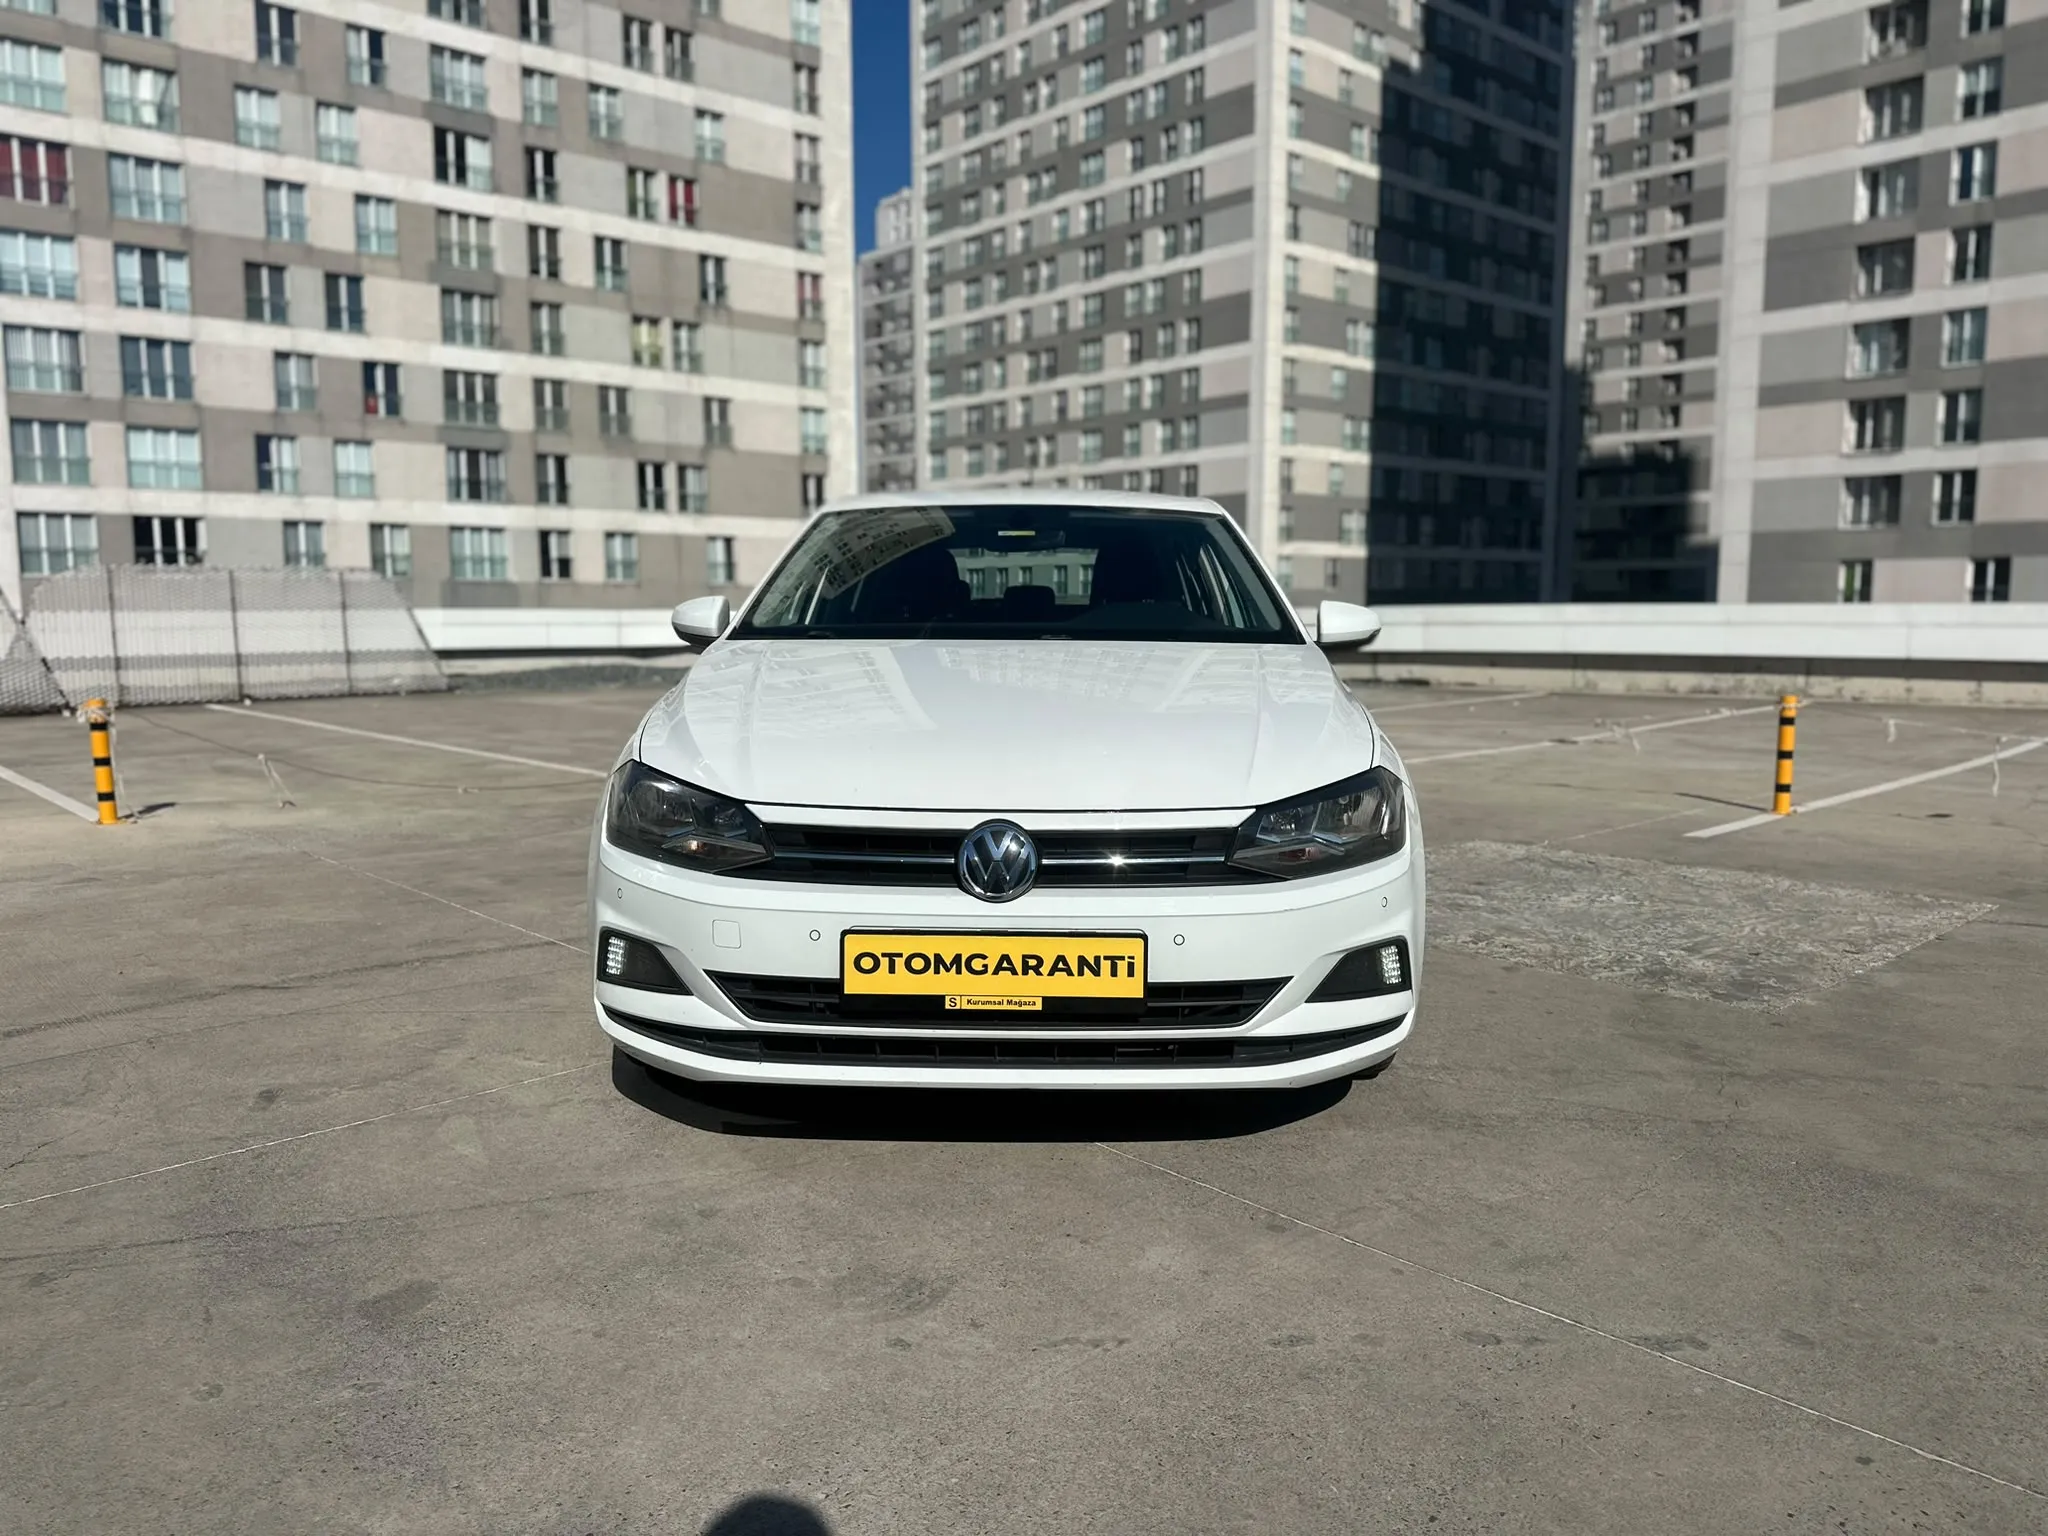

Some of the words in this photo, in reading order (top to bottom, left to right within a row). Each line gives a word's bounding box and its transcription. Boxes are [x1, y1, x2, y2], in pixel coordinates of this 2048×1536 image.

[962, 827, 1034, 896] VW
[948, 997, 957, 1007] S
[966, 998, 1004, 1006] Kurumsal
[1006, 998, 1036, 1007] Mağaza
